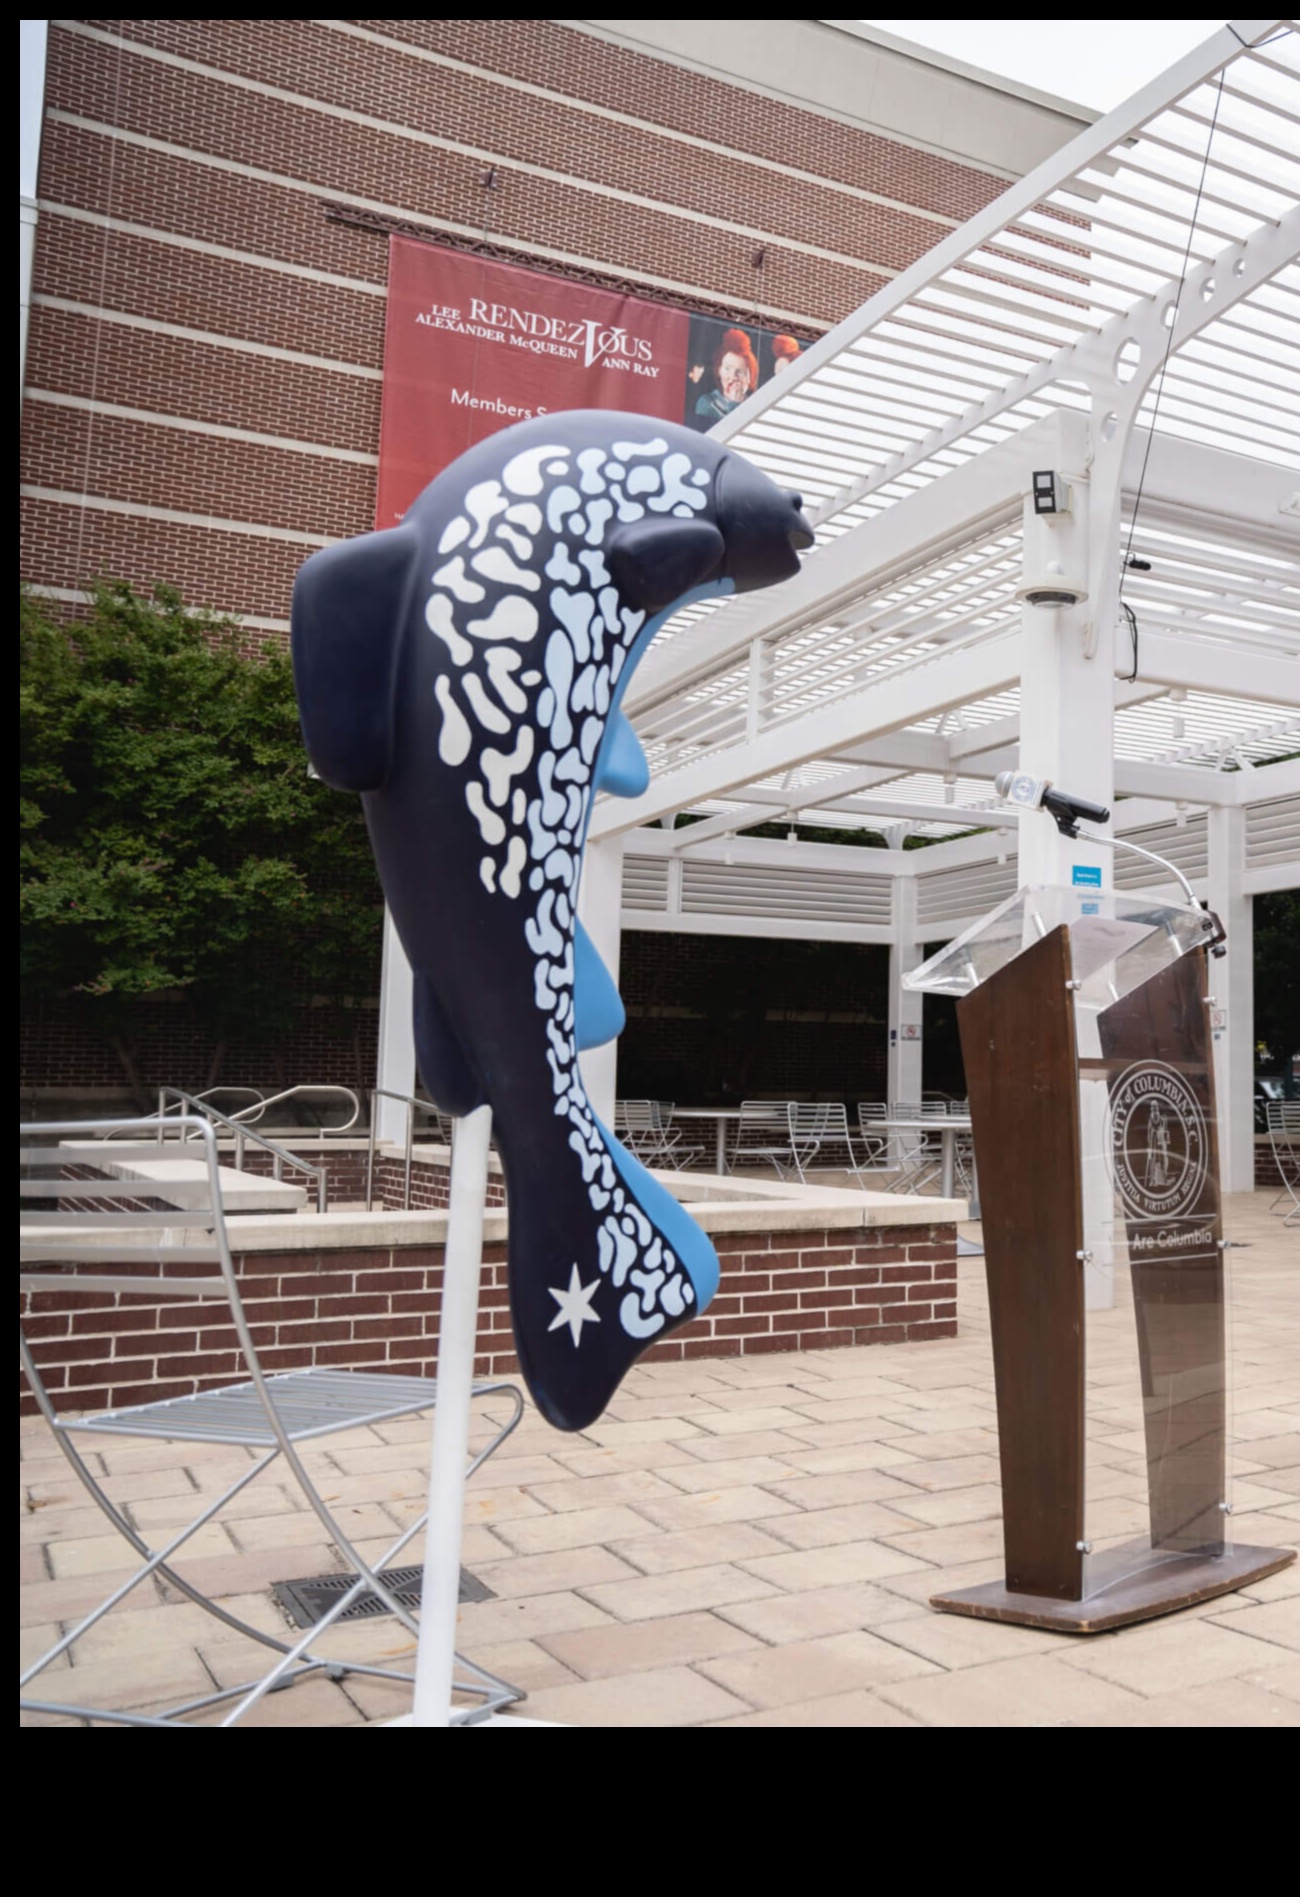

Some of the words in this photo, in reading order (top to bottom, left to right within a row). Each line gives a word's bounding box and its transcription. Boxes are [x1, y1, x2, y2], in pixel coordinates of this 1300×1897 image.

[432, 304, 461, 320] LEE
[415, 312, 506, 343] ALEXANDER
[509, 334, 578, 360] McQUEEN
[468, 298, 653, 368] RENDEZVOUS
[601, 357, 630, 371] ANN
[633, 362, 659, 378] RAY
[451, 388, 532, 420] Members
[1112, 1100, 1127, 1147] CITY
[1132, 1233, 1155, 1250] Are
[1157, 1229, 1212, 1248] Columbia
